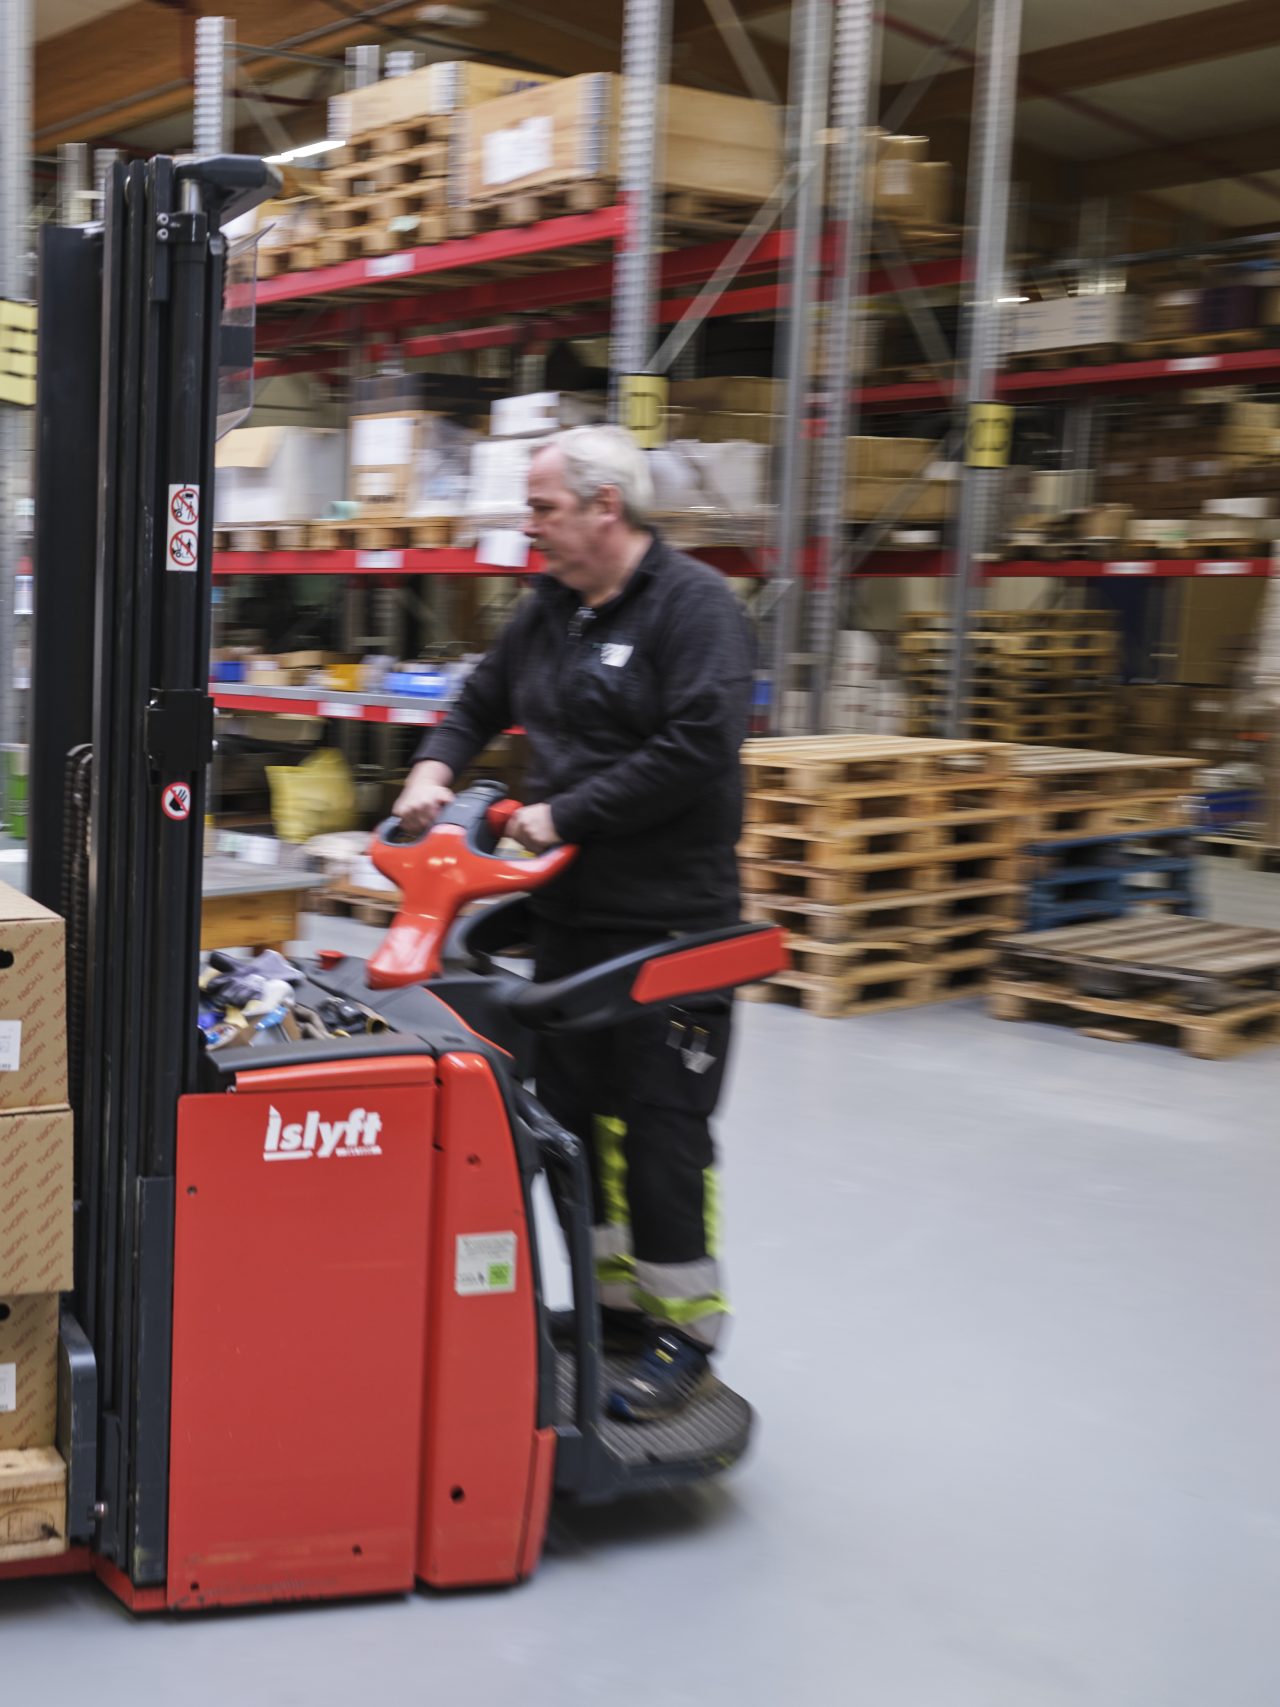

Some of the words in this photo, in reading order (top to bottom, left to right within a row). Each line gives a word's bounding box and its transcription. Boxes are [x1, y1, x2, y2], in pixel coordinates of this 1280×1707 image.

[1, 1140, 28, 1168] THORN
[36, 1162, 63, 1189] THORN
[1, 1186, 29, 1214] THORN
[36, 1208, 63, 1235] THORN
